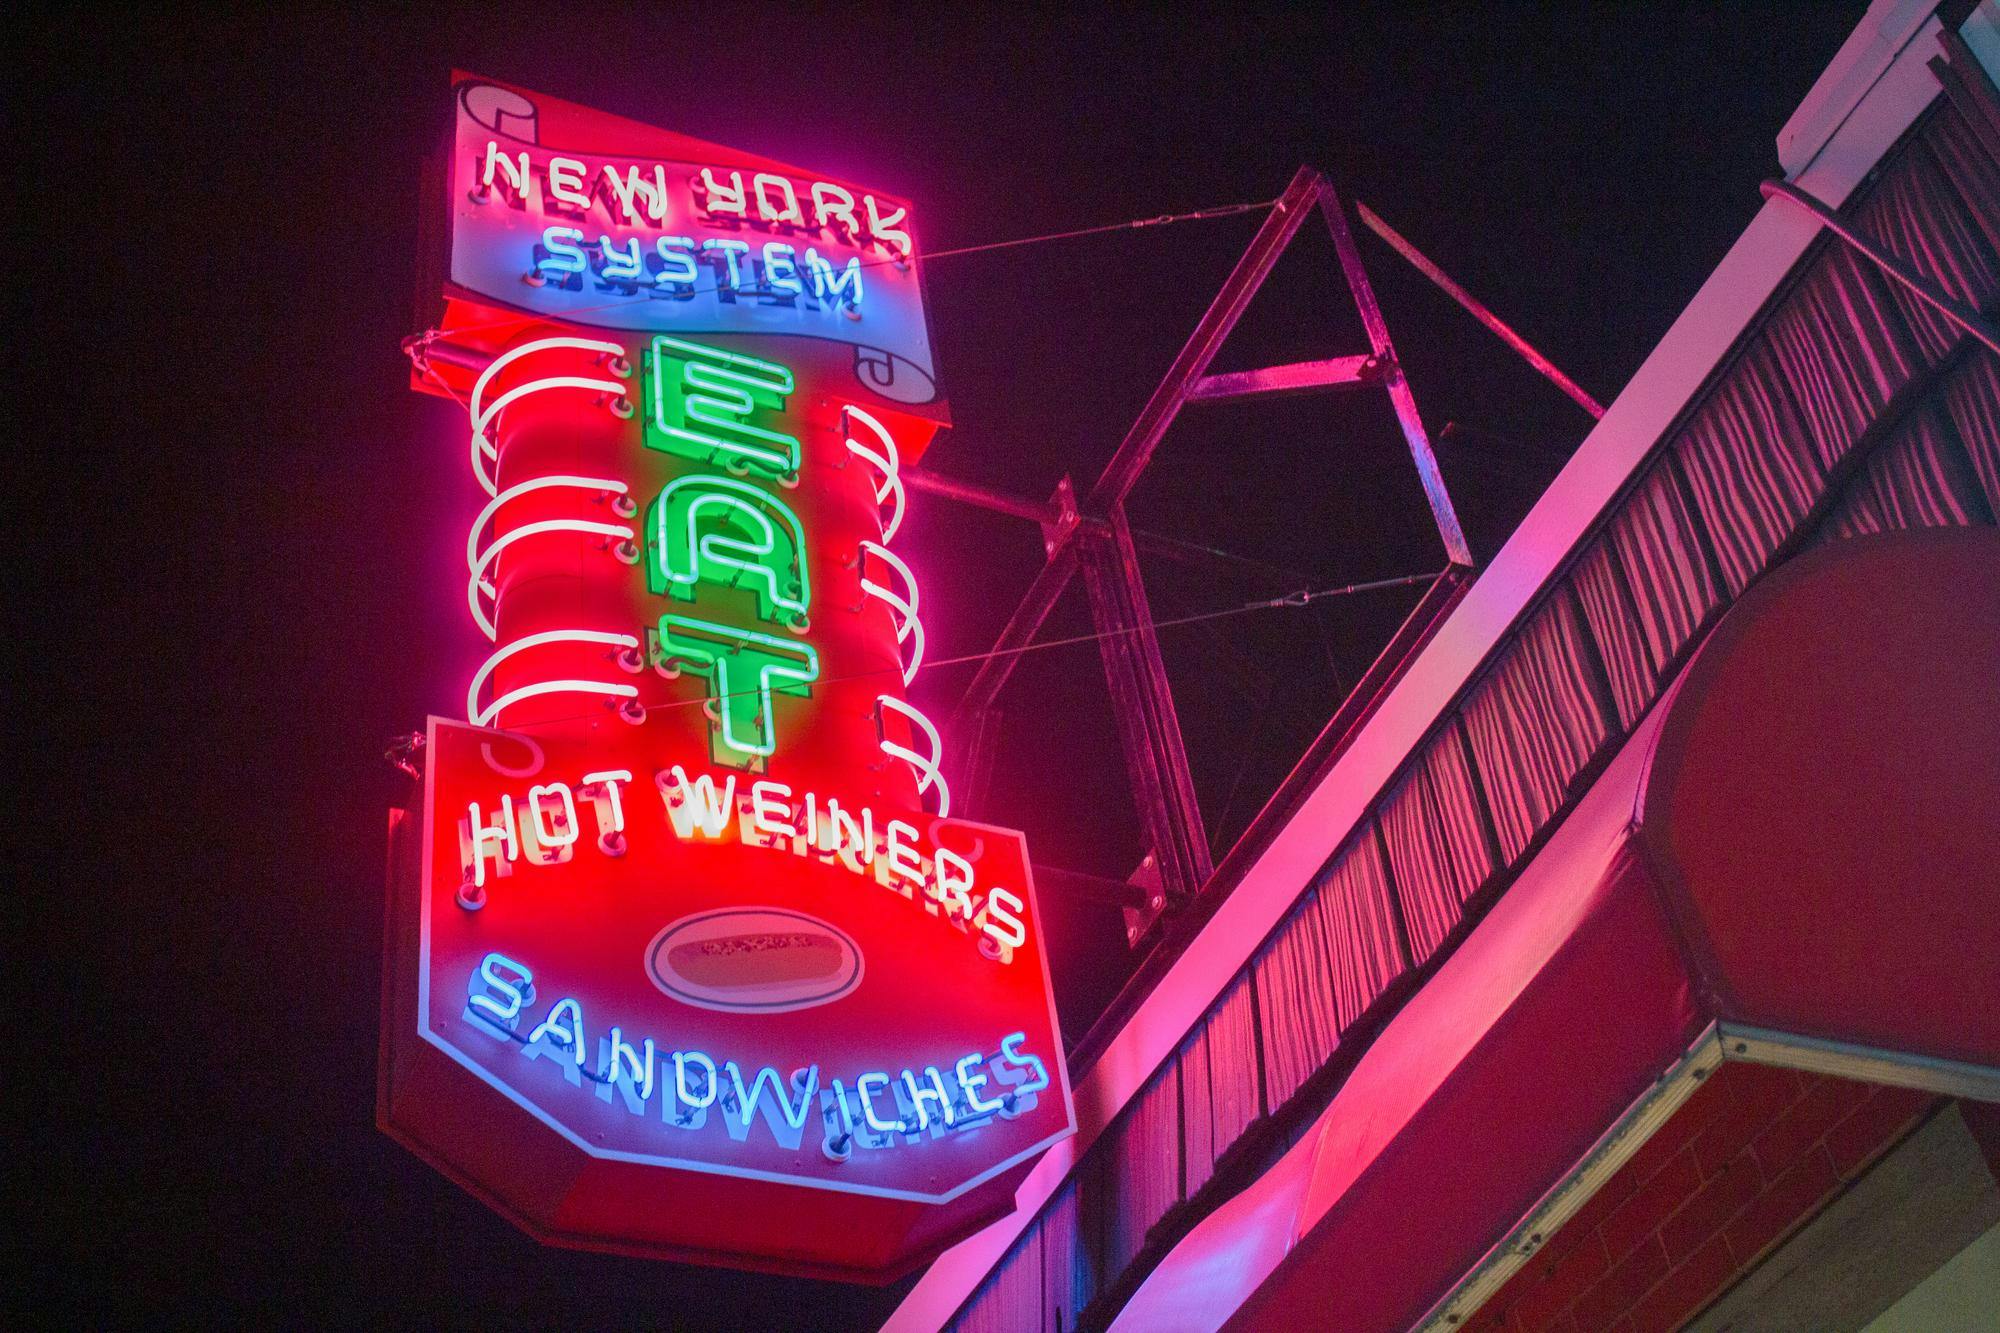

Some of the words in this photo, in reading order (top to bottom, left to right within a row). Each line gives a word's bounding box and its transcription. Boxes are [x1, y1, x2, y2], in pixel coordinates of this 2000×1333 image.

[480, 140, 669, 224] NEW
[697, 166, 914, 256] YORK
[534, 226, 865, 308] SYSTEM
[643, 334, 819, 773] EAT
[464, 769, 632, 888] HOT
[668, 765, 1026, 952] WEINERS
[465, 951, 1051, 1140] SANDWICHES
